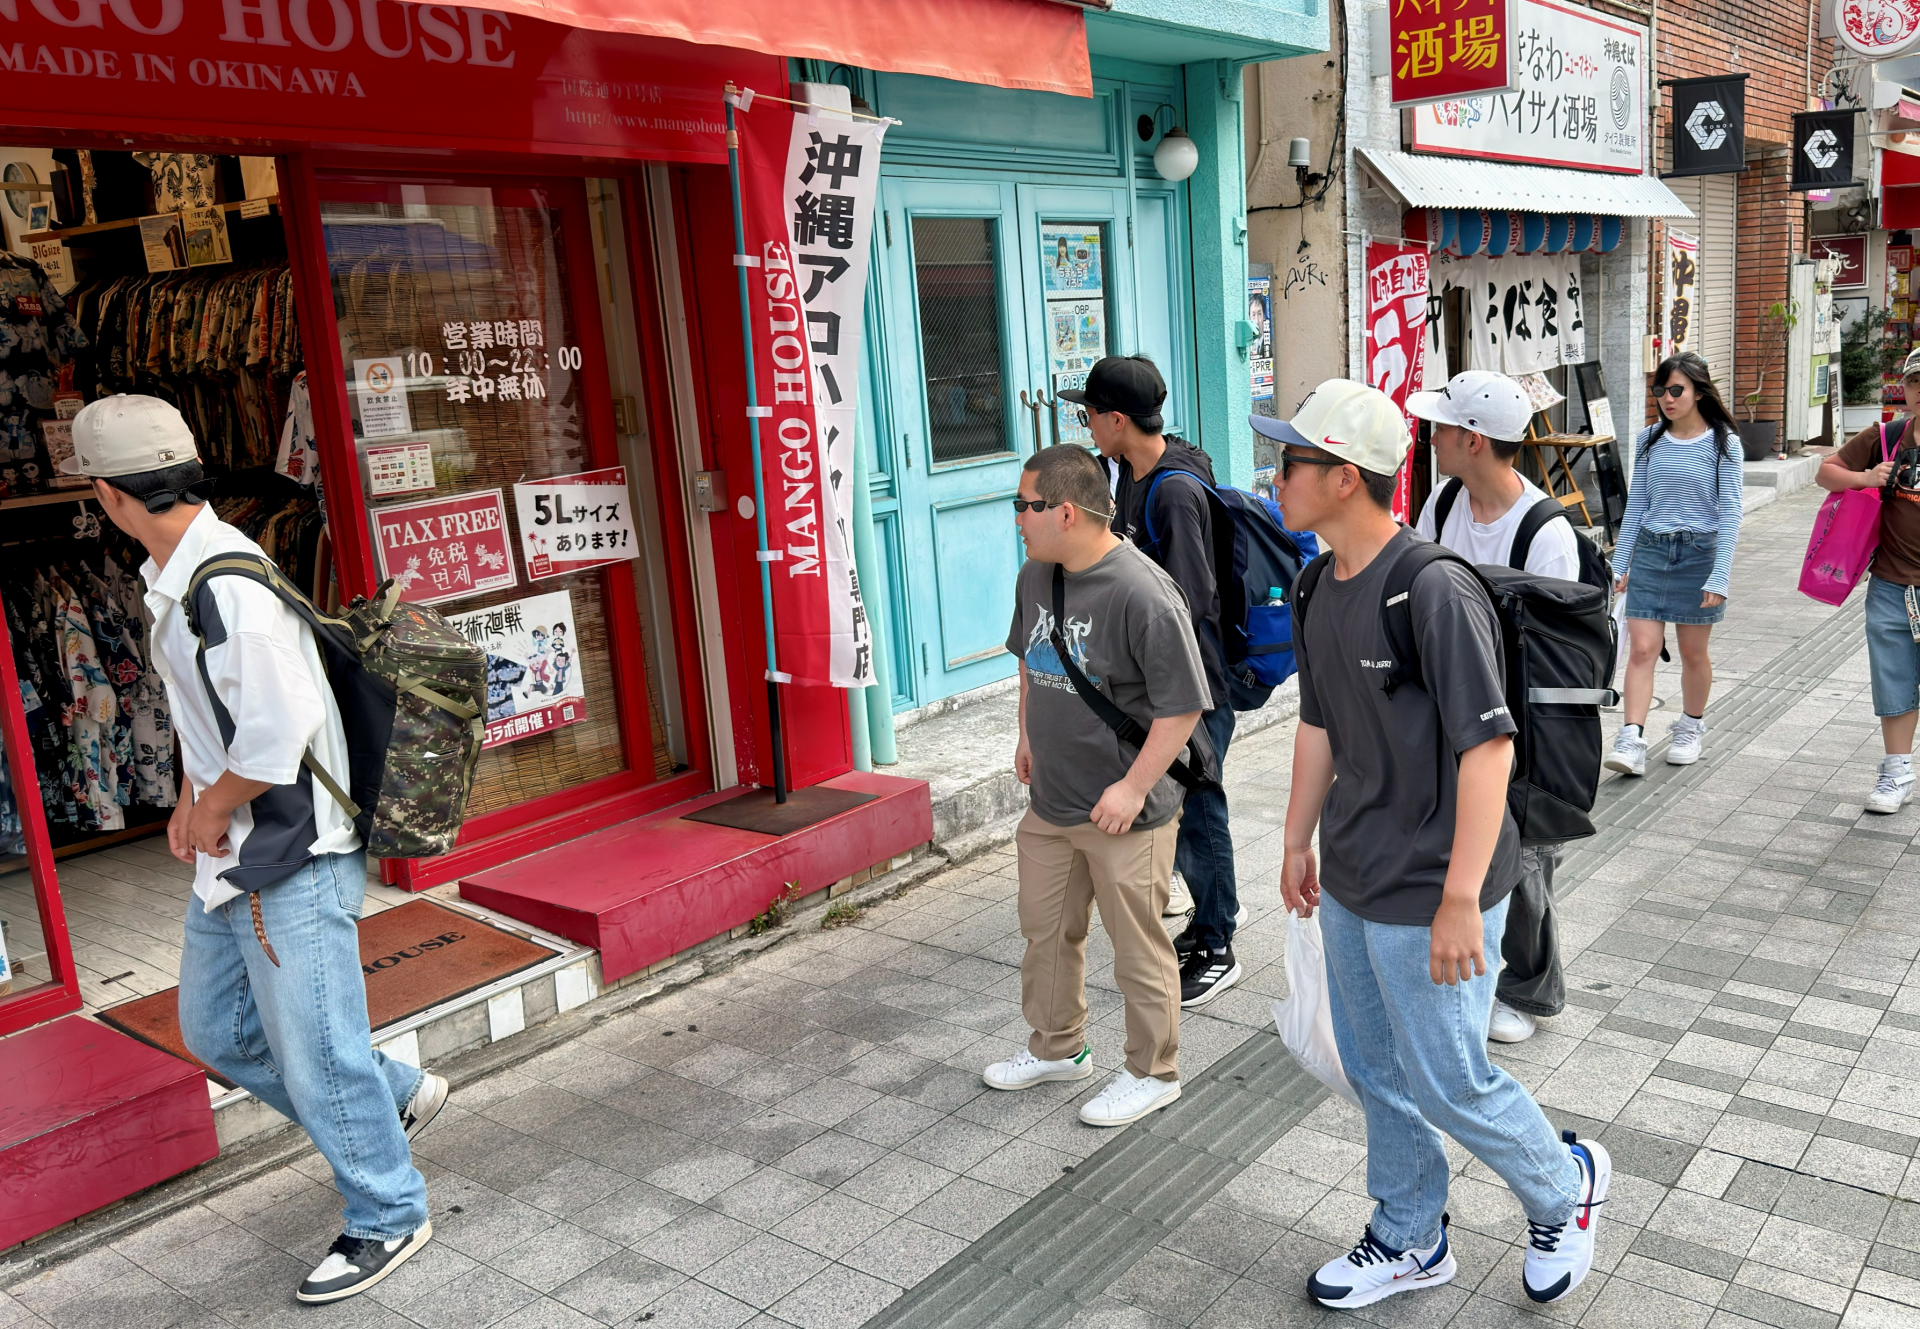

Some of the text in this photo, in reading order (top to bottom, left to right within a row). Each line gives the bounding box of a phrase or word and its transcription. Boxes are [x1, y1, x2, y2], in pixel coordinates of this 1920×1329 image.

[218, 0, 516, 69] HOUSE
[1396, 15, 1501, 80] 酒場
[1603, 37, 1636, 67] 沖縄そば
[0, 42, 367, 98] MADE IN OKINAWA
[1487, 88, 1599, 144] ハイサイ酒場
[32, 244, 61, 260] BIG size
[1074, 304, 1090, 316] OBP
[443, 320, 544, 350] 営業時間
[366, 395, 399, 405] 飲食禁止
[446, 372, 546, 404] 年中無休
[764, 240, 821, 578] MANGO HOUSE
[382, 506, 501, 549] TAX FREE
[426, 543, 469, 570] 免税
[1819, 563, 1844, 580] 沖縄
[431, 564, 472, 591] 면제
[1033, 677, 1051, 688] SILENT
[1044, 672, 1061, 682] TRUST
